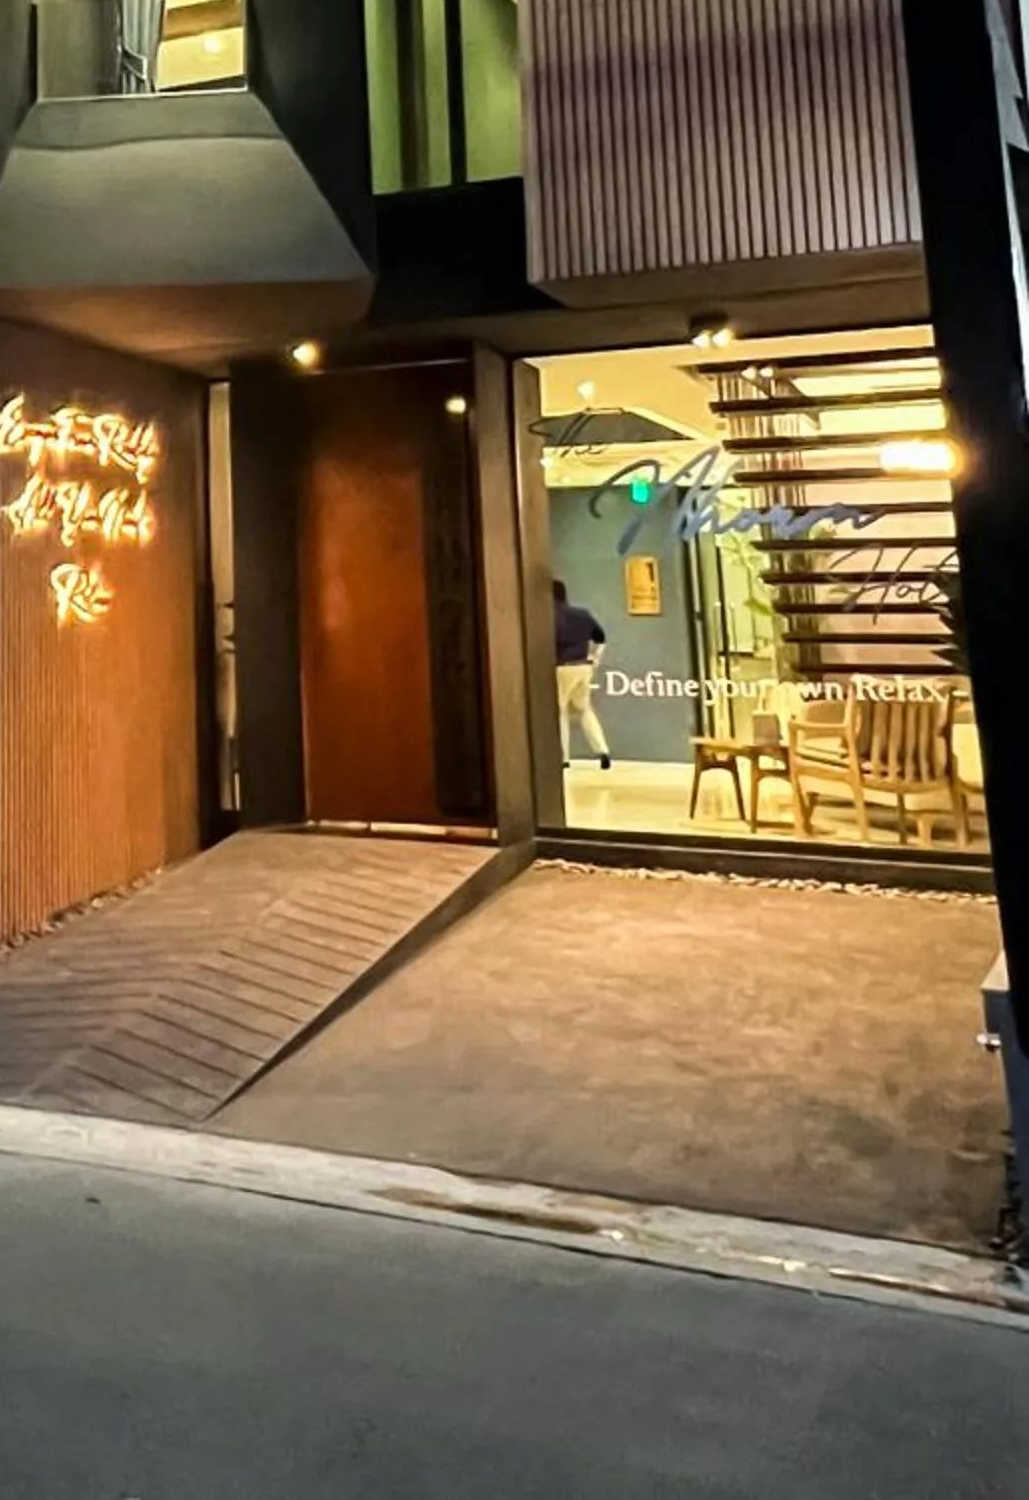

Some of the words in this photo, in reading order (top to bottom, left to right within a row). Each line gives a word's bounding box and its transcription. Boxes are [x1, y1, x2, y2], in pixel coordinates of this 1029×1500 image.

[604, 671, 700, 698] Define
[703, 678, 775, 707] your
[850, 672, 947, 702] Relax
